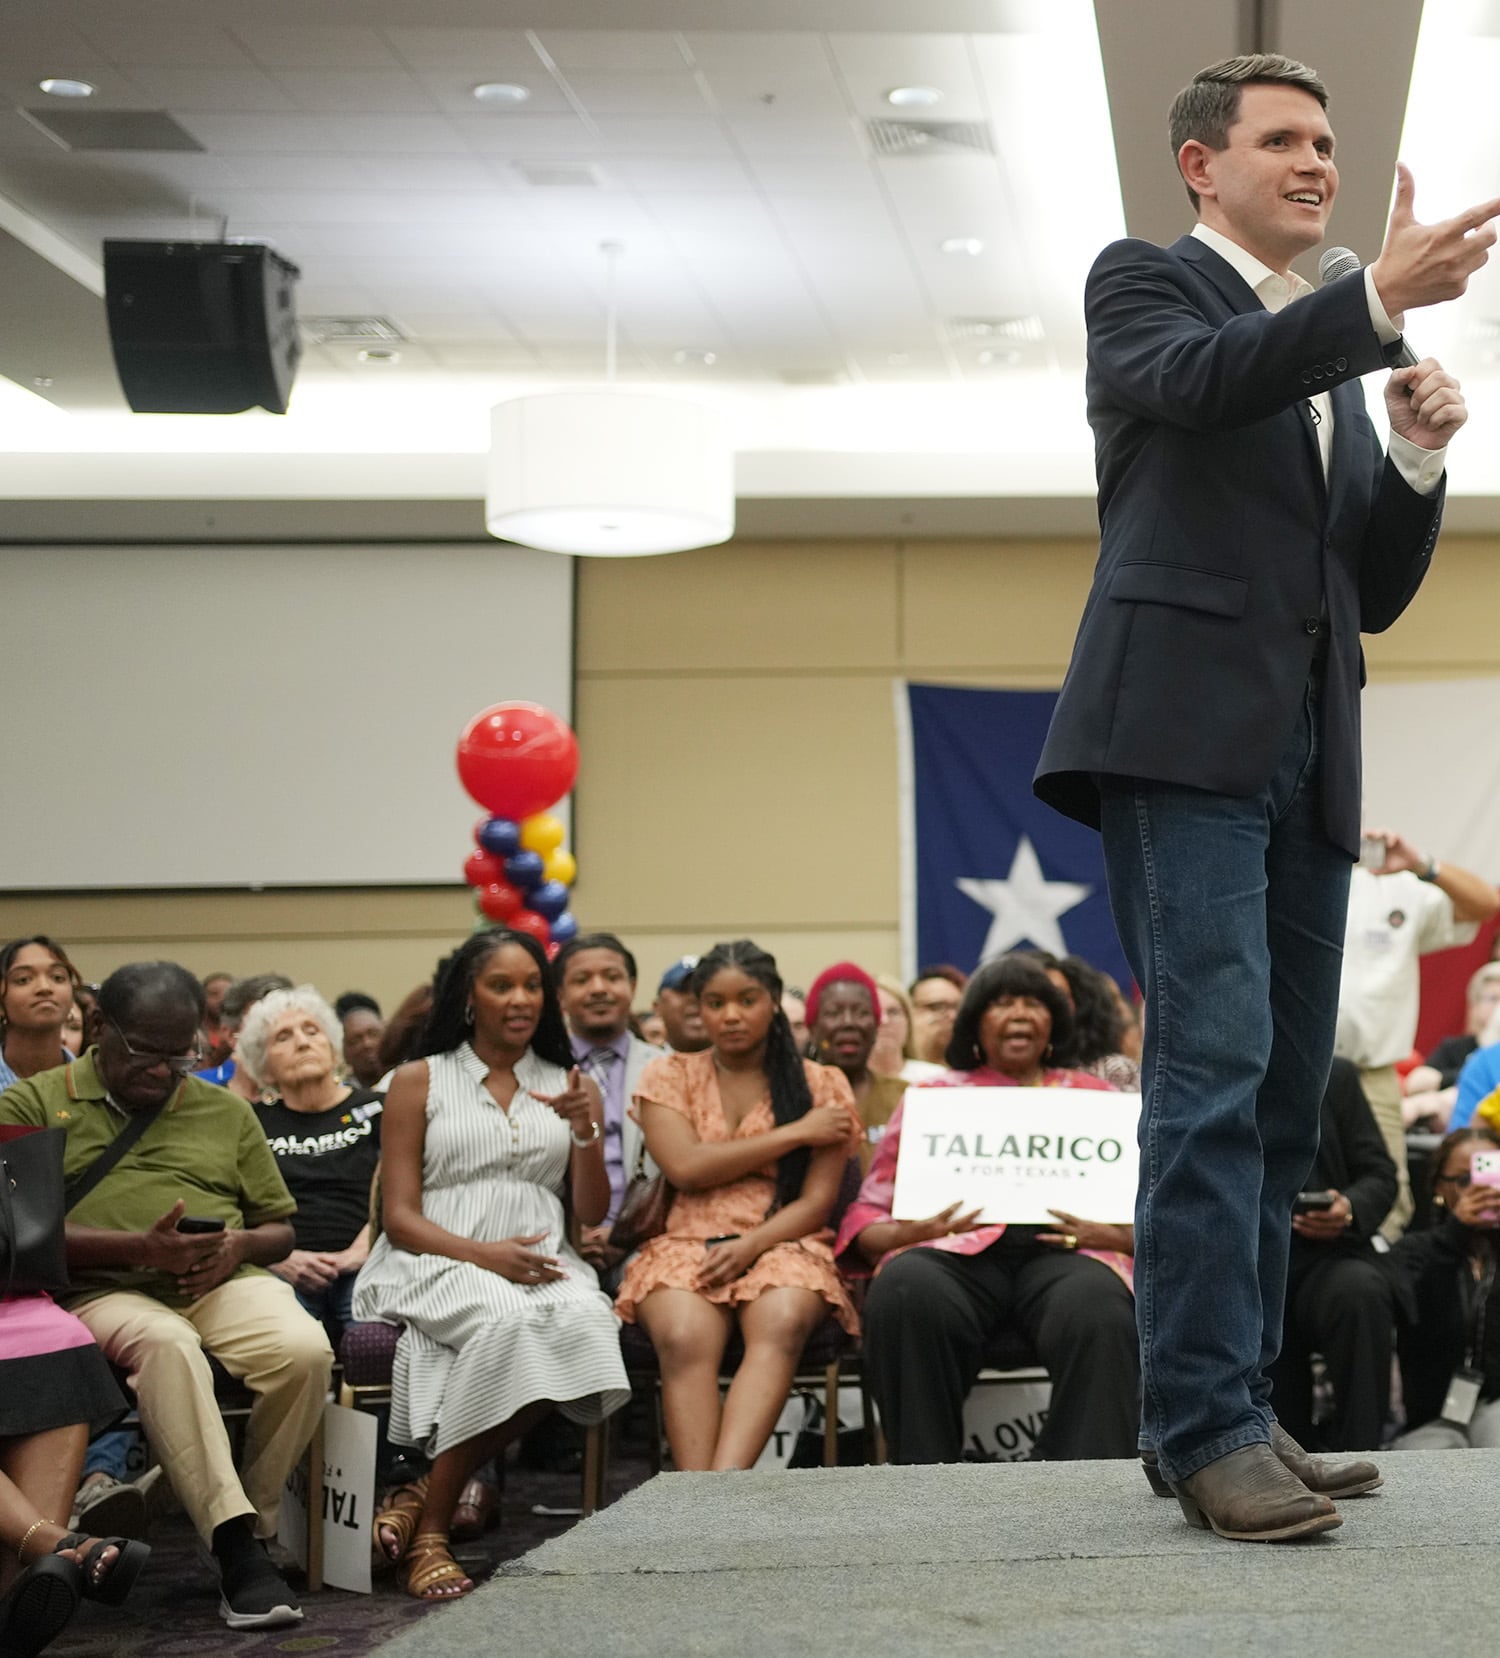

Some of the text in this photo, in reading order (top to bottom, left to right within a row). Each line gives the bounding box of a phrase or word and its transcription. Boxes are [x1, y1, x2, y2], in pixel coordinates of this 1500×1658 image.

[922, 1134, 1123, 1163] TALARICO
[971, 1166, 1072, 1179] FOR TEXAS
